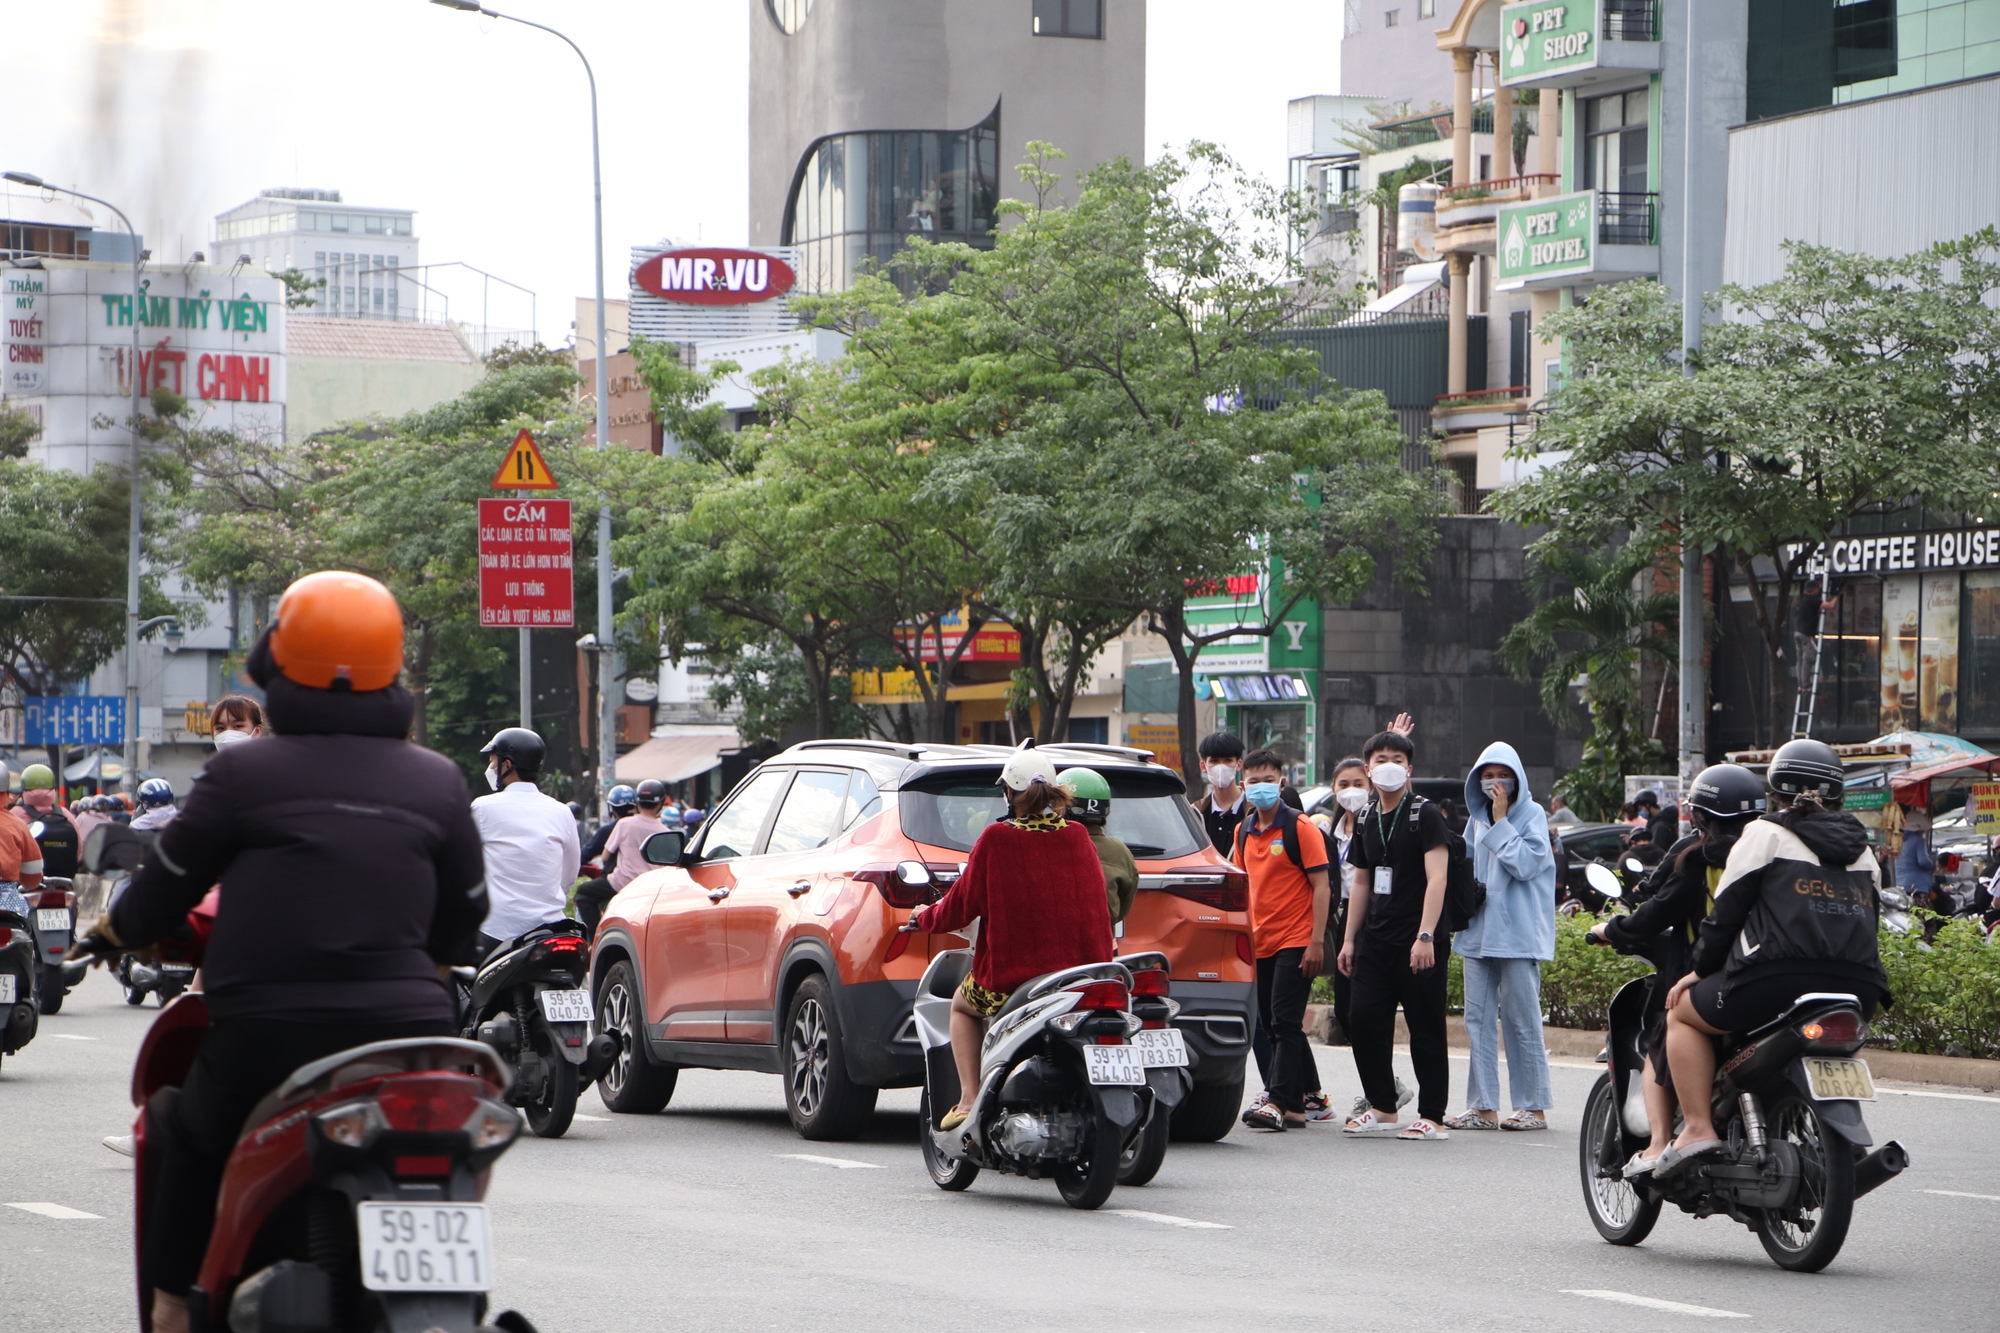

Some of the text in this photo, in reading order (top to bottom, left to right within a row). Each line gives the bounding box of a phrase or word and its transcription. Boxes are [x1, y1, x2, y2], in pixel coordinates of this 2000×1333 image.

[1532, 6, 1566, 33] PET
[1543, 31, 1590, 61] SHOP
[1526, 211, 1559, 237] PET
[1530, 237, 1587, 267] HOTEL
[661, 257, 769, 292] MR VU
[178, 289, 212, 329] MỸ
[218, 292, 267, 341] VIỆN
[12, 373, 38, 382] 441
[503, 500, 546, 522] CẤM
[481, 524, 571, 544] CÁC LOẠI XE CÓ TẢI TRỌNG
[481, 551, 498, 568] TOÀN
[500, 551, 509, 571] BỘ
[512, 555, 521, 568] XE
[523, 551, 535, 568] LỚN
[552, 555, 559, 568] 10
[1832, 536, 1916, 573] COFFEE
[1924, 530, 2000, 567] HOUSE
[505, 580, 545, 596] LƯU THÔNG
[482, 606, 496, 623] LÊN
[533, 606, 551, 623] HÀNG
[553, 609, 571, 623] XANH
[549, 993, 584, 1006] 59-G3
[549, 1006, 590, 1020] 040.79
[1138, 1032, 1175, 1048] 59-S1
[1092, 1047, 1132, 1064] 59-P1
[1091, 1065, 1142, 1083] 544.05
[1813, 1060, 1861, 1079] 76-F1
[379, 1209, 471, 1244] 59-D2
[372, 1249, 481, 1284] 406.11
